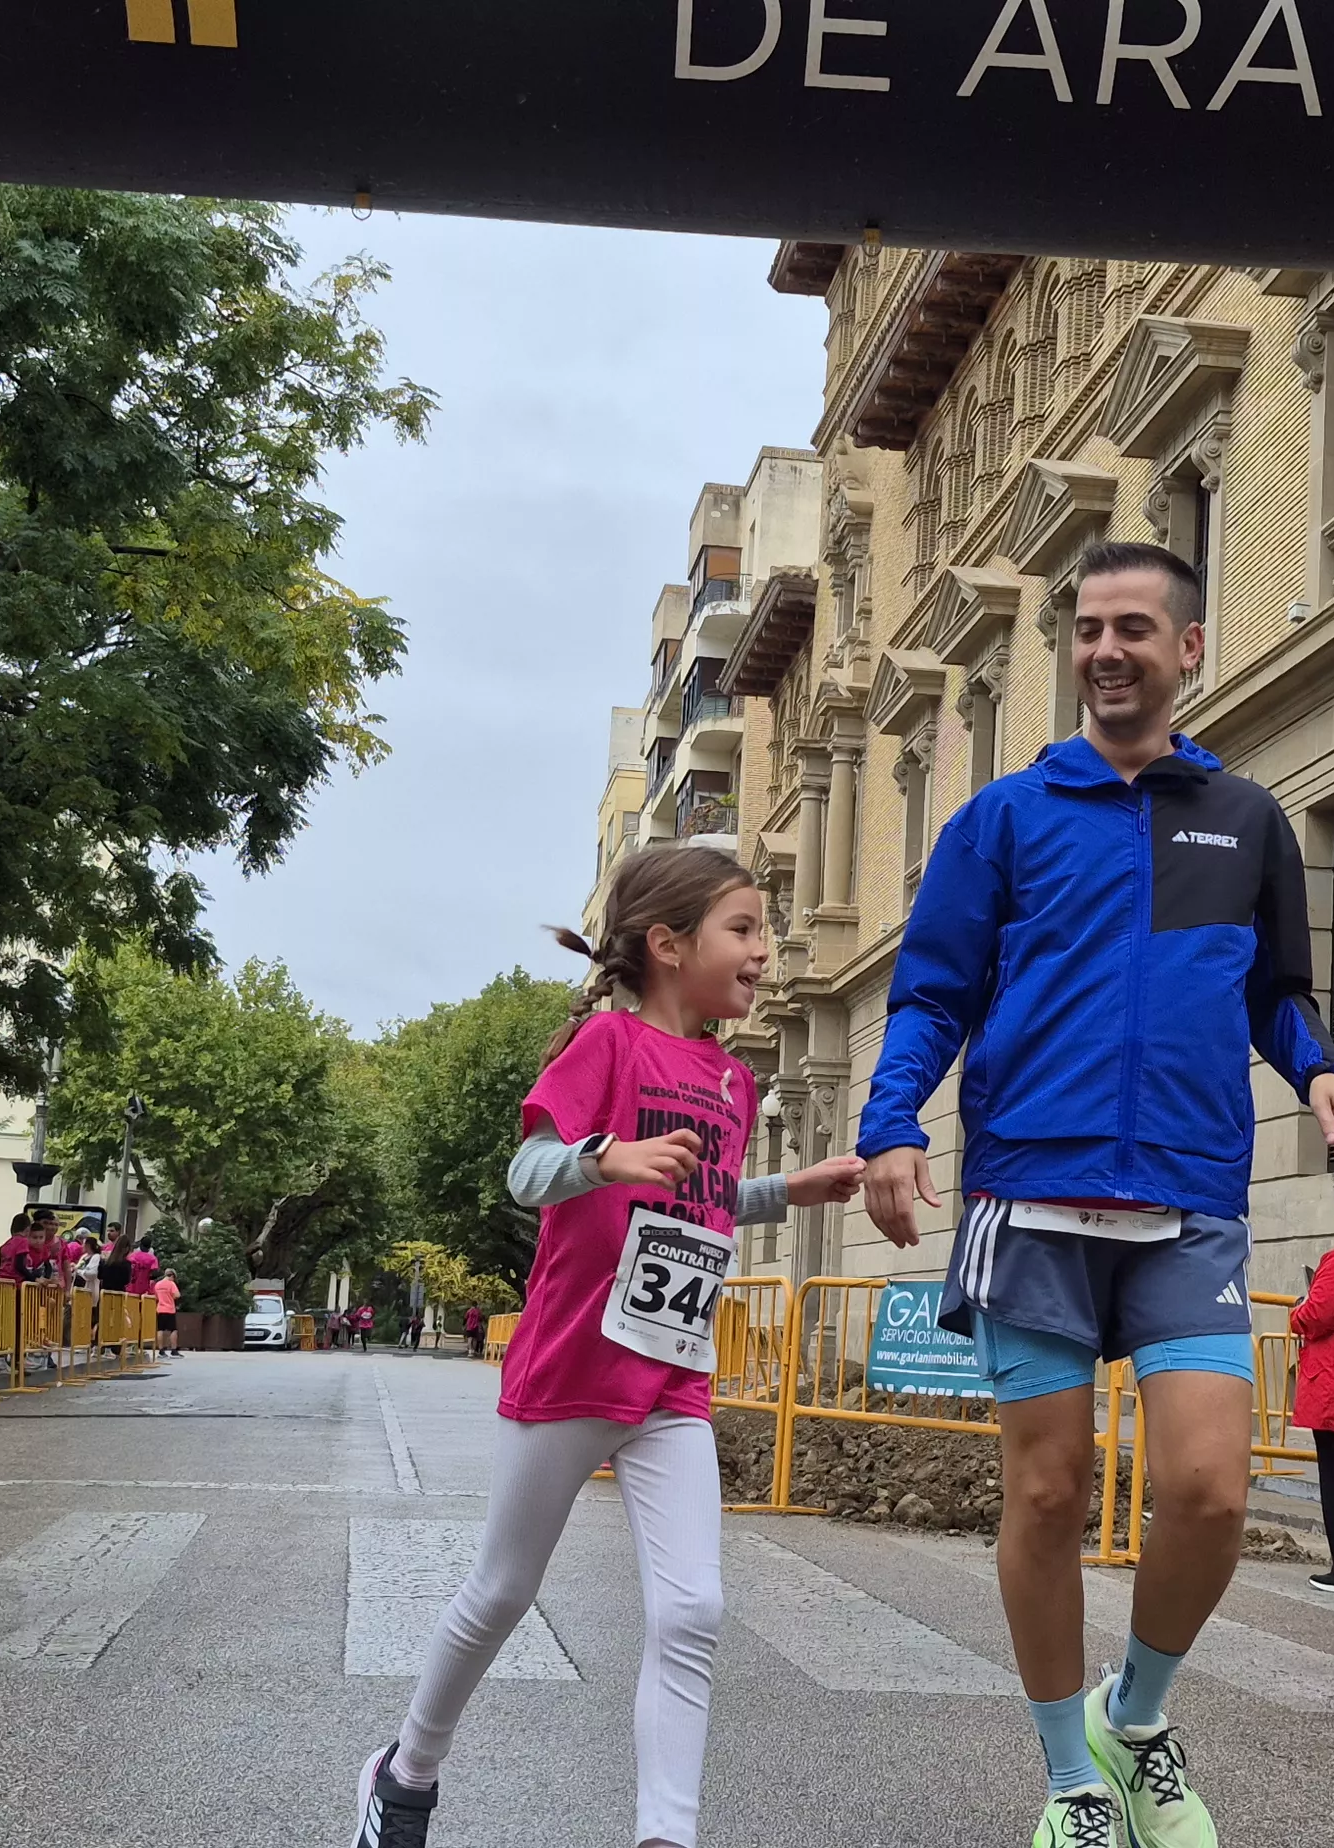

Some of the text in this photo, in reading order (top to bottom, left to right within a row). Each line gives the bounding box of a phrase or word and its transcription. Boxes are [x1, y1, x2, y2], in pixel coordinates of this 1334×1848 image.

[675, 0, 890, 92] DE
[1188, 831, 1239, 849] TERREX
[682, 1093, 716, 1113] CONTRA
[648, 1241, 704, 1268] CONTRA
[707, 1256, 716, 1271] EL
[699, 1244, 724, 1259] HUESCA
[887, 1291, 943, 1329] GA
[880, 1327, 931, 1345] SERVICIOS
